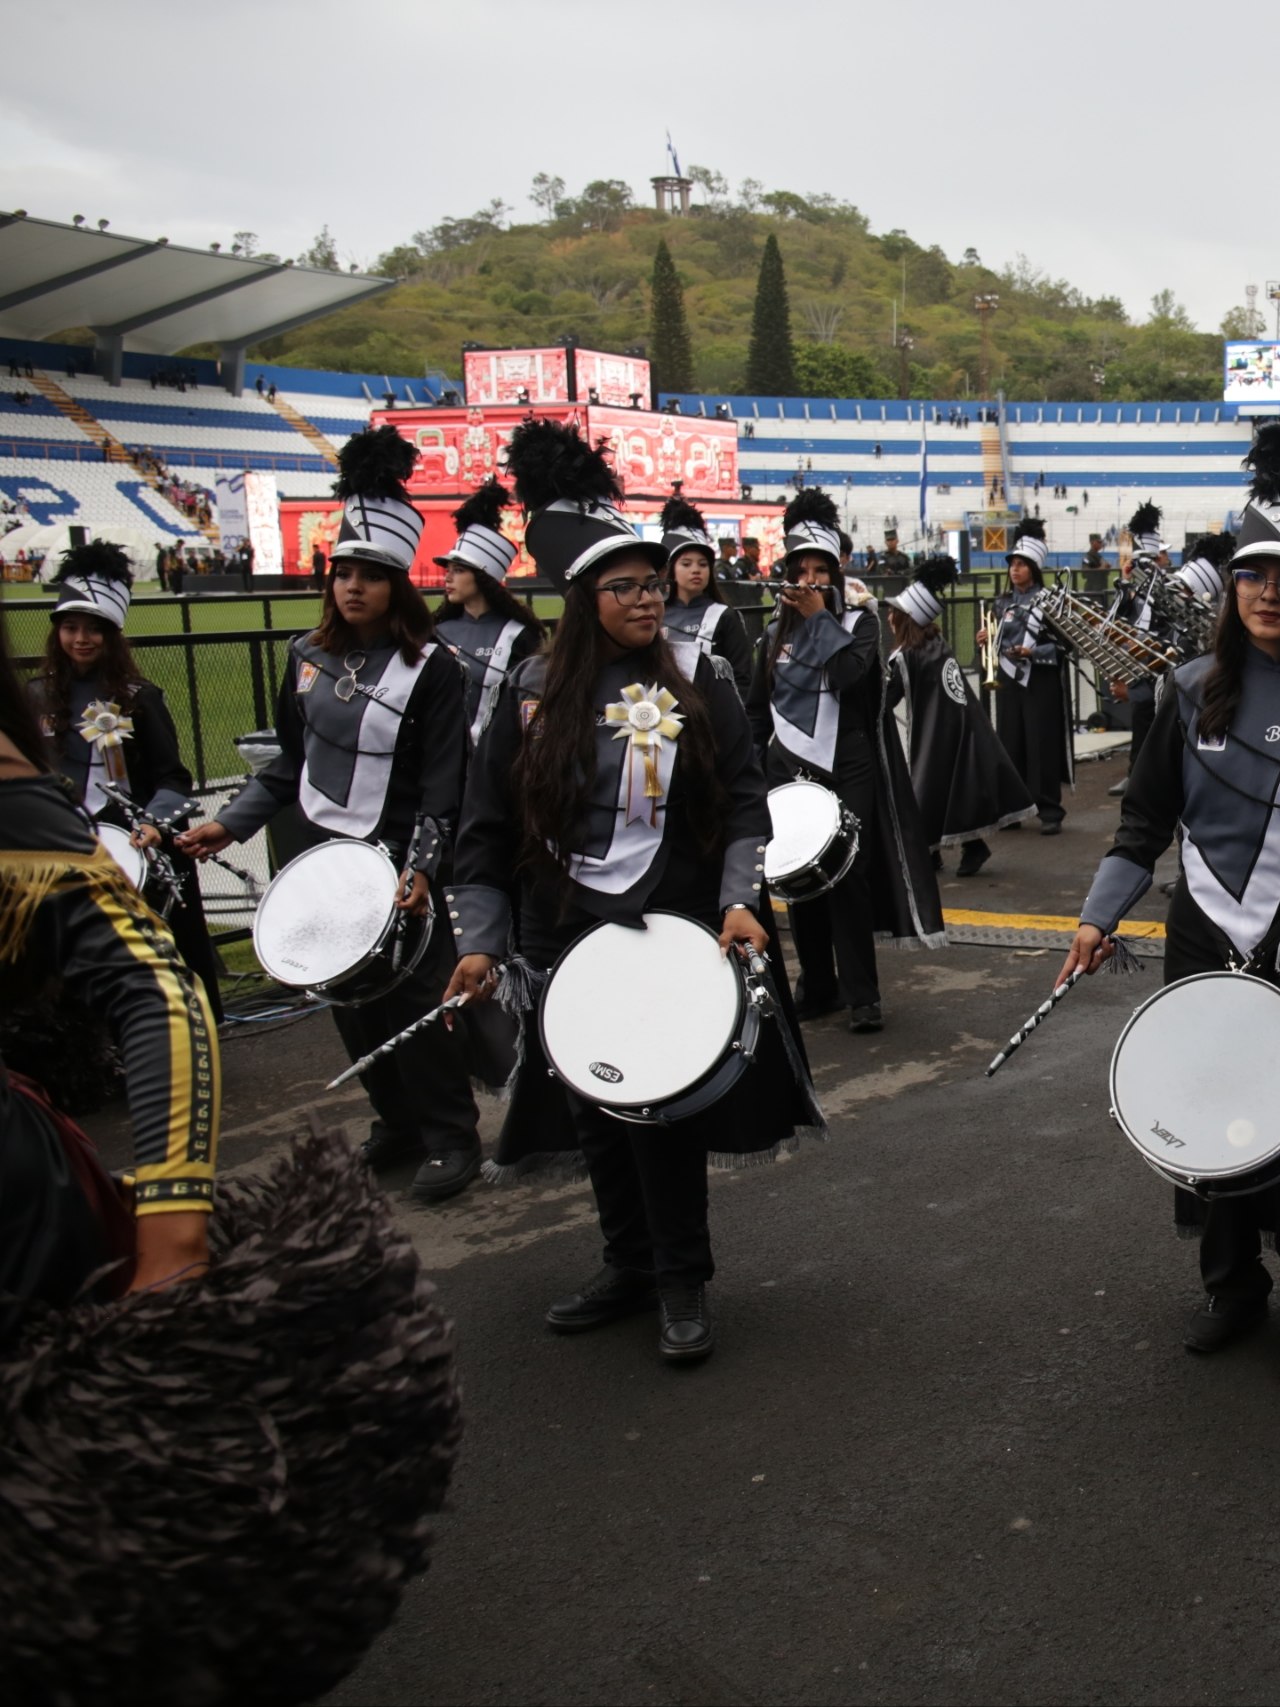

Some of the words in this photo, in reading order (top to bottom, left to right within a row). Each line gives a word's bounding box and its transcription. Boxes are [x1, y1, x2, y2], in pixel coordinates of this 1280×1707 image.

[474, 647, 503, 657] BDG
[593, 1063, 621, 1082] ESM
[1150, 1121, 1187, 1149] LAZER
